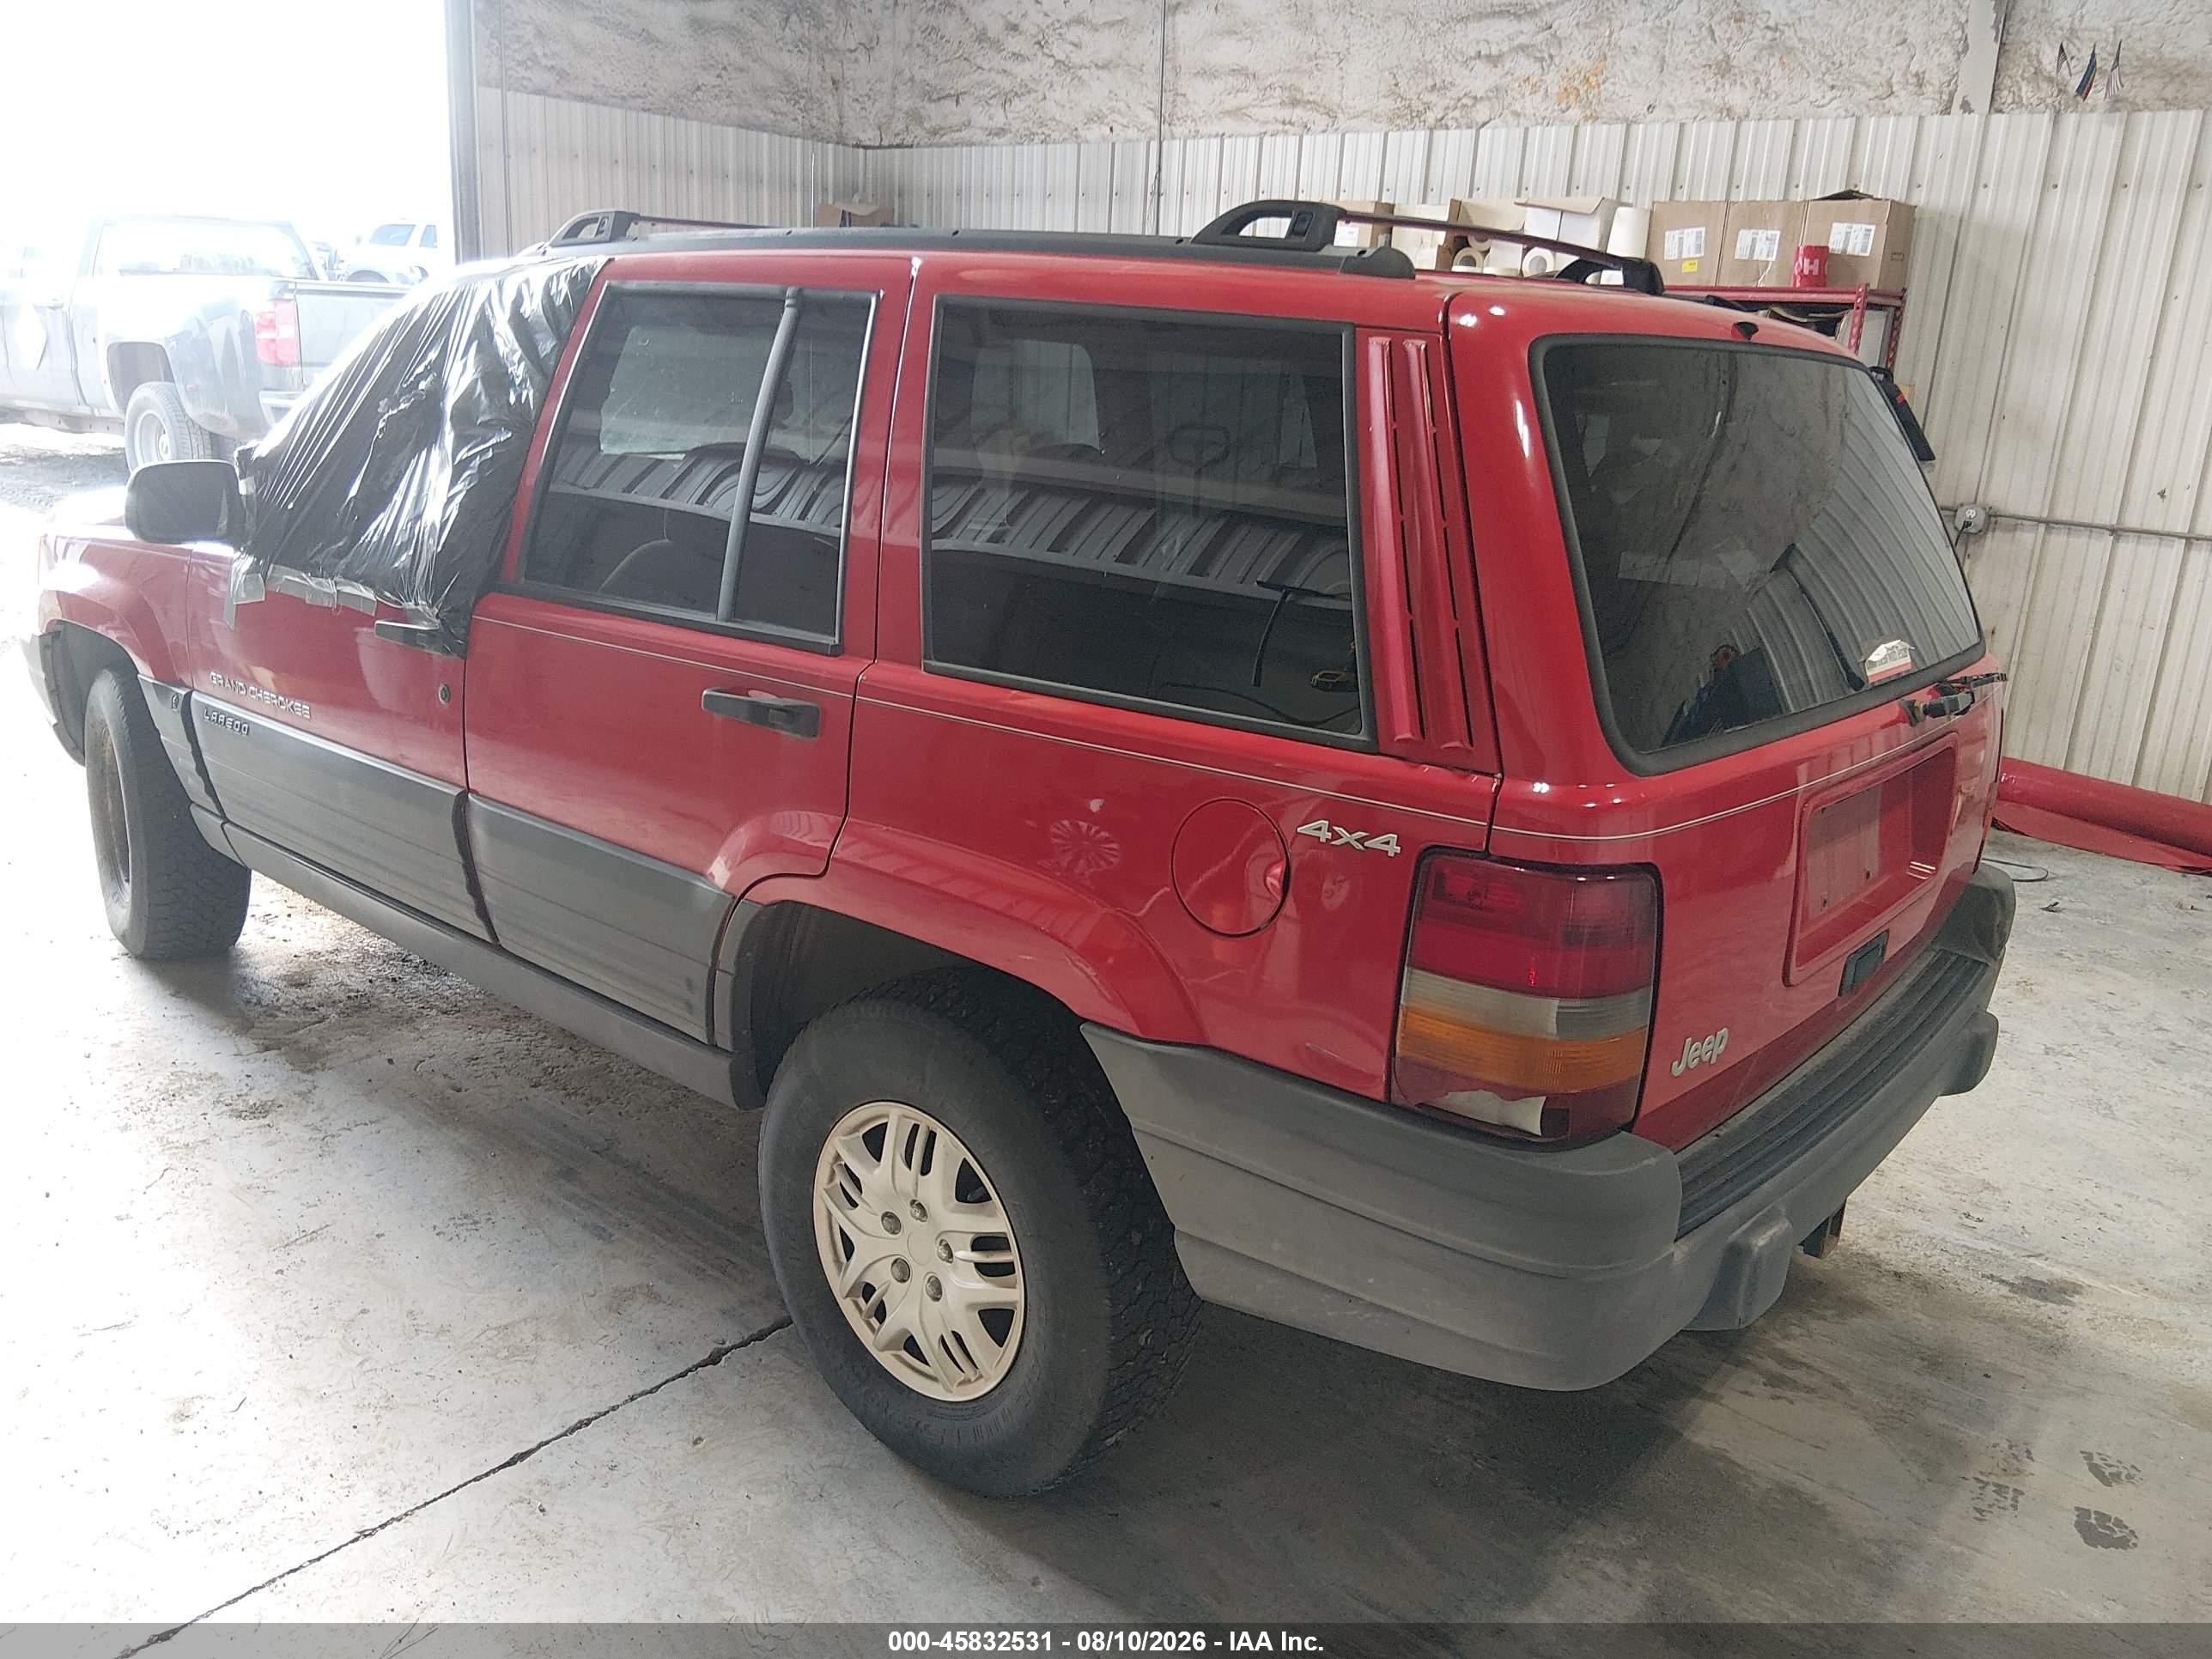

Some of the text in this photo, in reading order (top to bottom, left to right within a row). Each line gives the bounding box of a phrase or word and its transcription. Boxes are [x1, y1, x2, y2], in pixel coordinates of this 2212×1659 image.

[210, 672, 311, 720] GRAND CHEROKEE
[204, 708, 249, 736] LAREDO
[1670, 1027, 1729, 1077] Jeep
